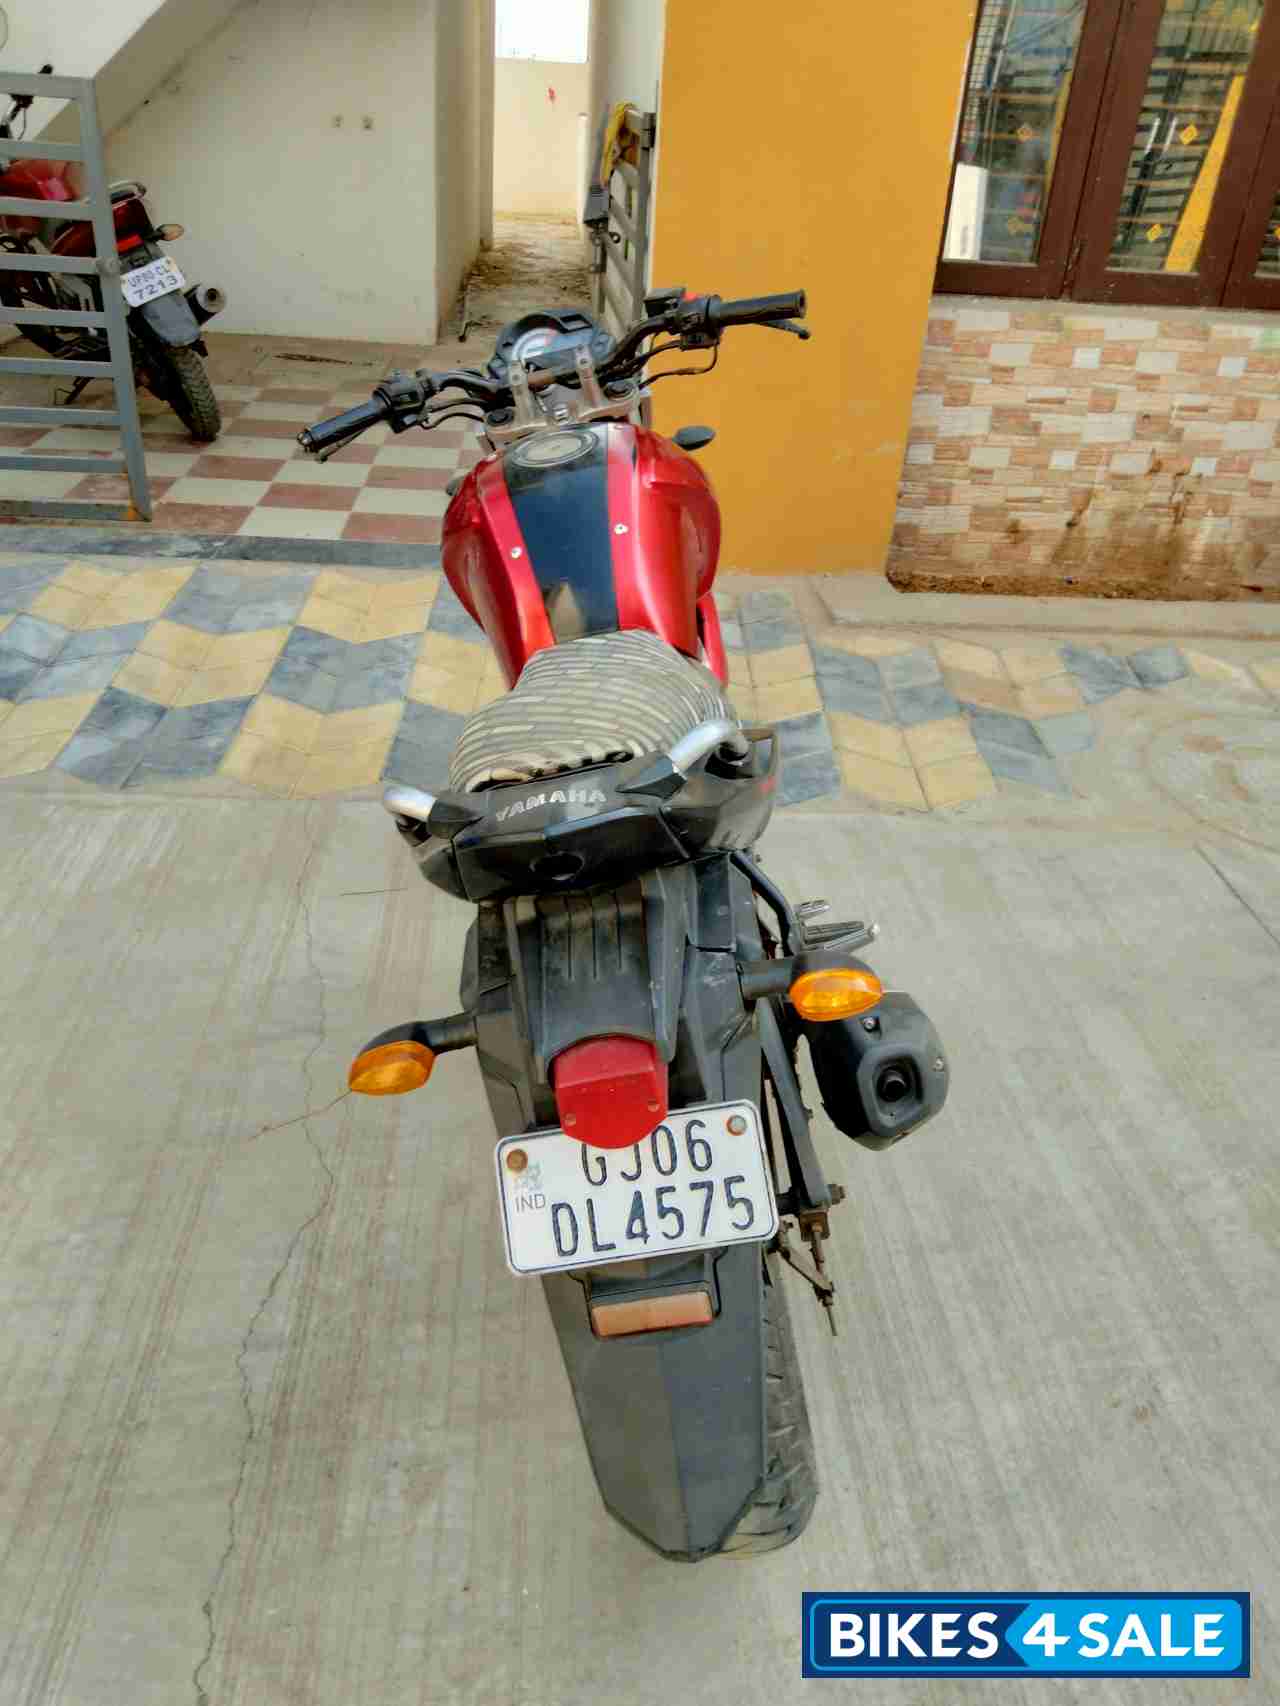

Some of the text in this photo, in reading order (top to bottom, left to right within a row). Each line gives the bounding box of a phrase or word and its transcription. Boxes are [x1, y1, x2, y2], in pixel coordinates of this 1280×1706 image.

[133, 275, 178, 300] 7213
[495, 790, 607, 822] YAMAHA
[581, 1119, 713, 1186] GJ06
[514, 1193, 546, 1213] IND
